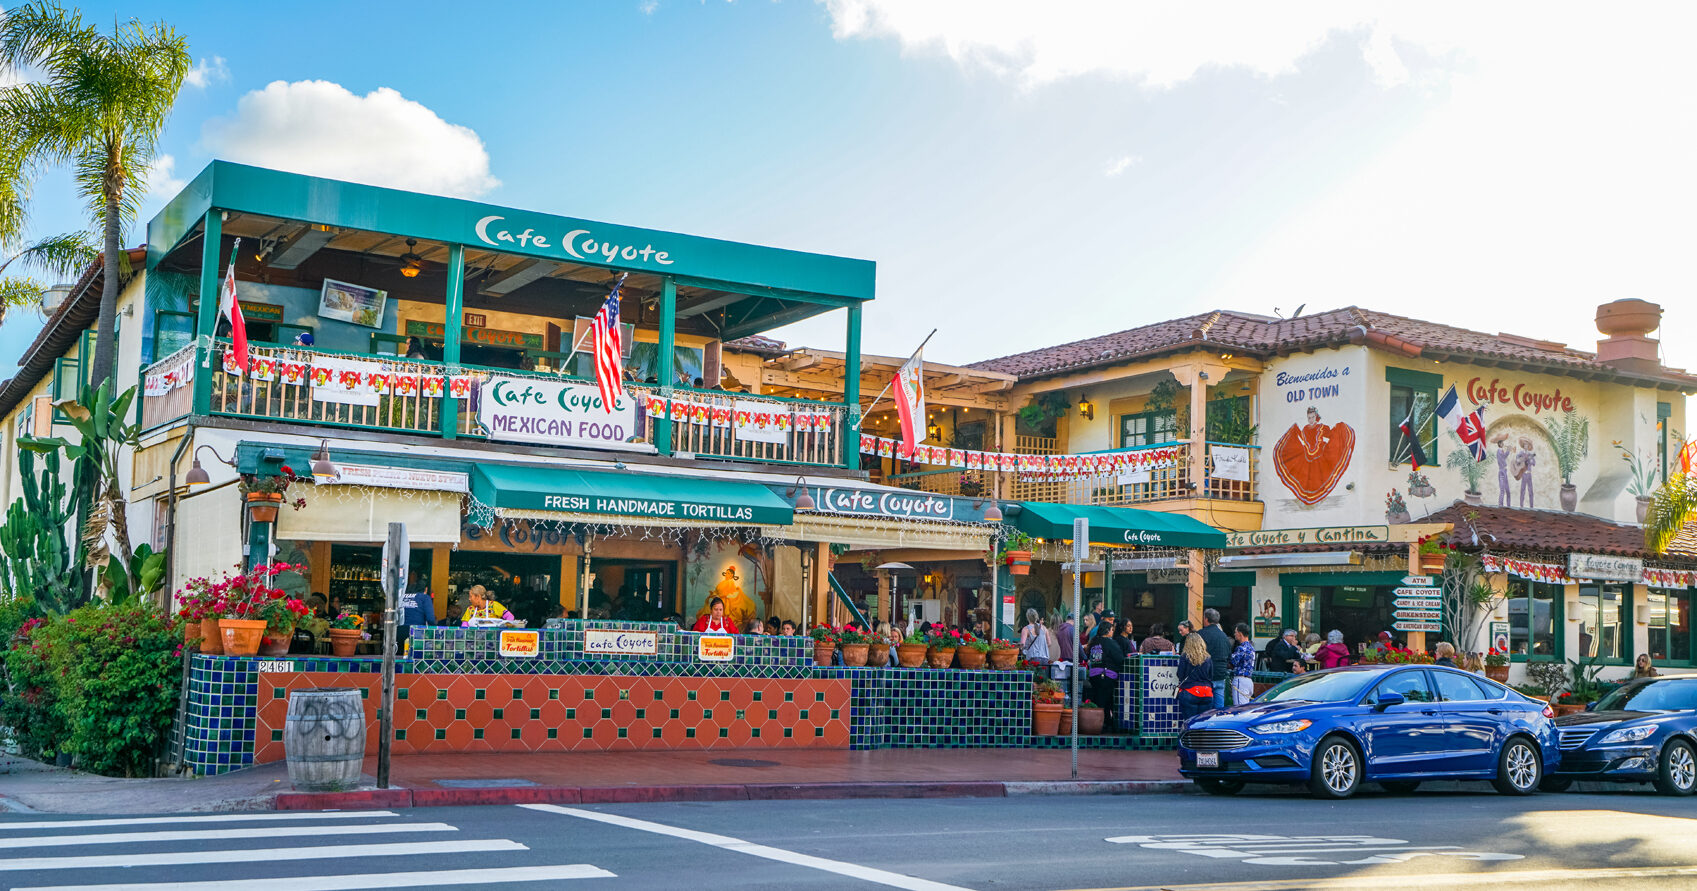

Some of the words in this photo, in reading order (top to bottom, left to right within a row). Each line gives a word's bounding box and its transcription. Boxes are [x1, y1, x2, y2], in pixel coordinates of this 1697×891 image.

[475, 216, 551, 247] Cafe
[562, 229, 674, 265] Coyote
[469, 315, 485, 326] EXIT
[467, 327, 526, 344] Coyote
[1276, 366, 1339, 386] Bienvenidos
[1342, 367, 1350, 376] a
[492, 380, 547, 407] Cafe
[558, 387, 625, 413] Coyoe
[1287, 389, 1305, 403] OLD
[1308, 384, 1339, 400] TOWN
[1467, 377, 1511, 405] Cafe
[1513, 383, 1574, 415] Coyote
[492, 414, 572, 437] MEXICAN
[579, 421, 625, 441] FOOD
[342, 467, 371, 477] FRESH
[544, 496, 590, 510] FRESH
[597, 499, 675, 515] HANDMADE
[682, 503, 753, 520] TORTILLAS
[824, 488, 875, 512] Cafe
[879, 492, 947, 517] Coyote
[1124, 529, 1138, 542] Cafe
[1140, 530, 1161, 542] Coyote
[1225, 533, 1244, 546] afe
[1249, 532, 1290, 546] Coyote
[1297, 532, 1306, 544] y
[1315, 527, 1378, 543] Cantina
[590, 638, 613, 649] cafe
[616, 634, 654, 650] Coyote
[260, 661, 291, 672] 2461
[1157, 671, 1173, 679] cafe
